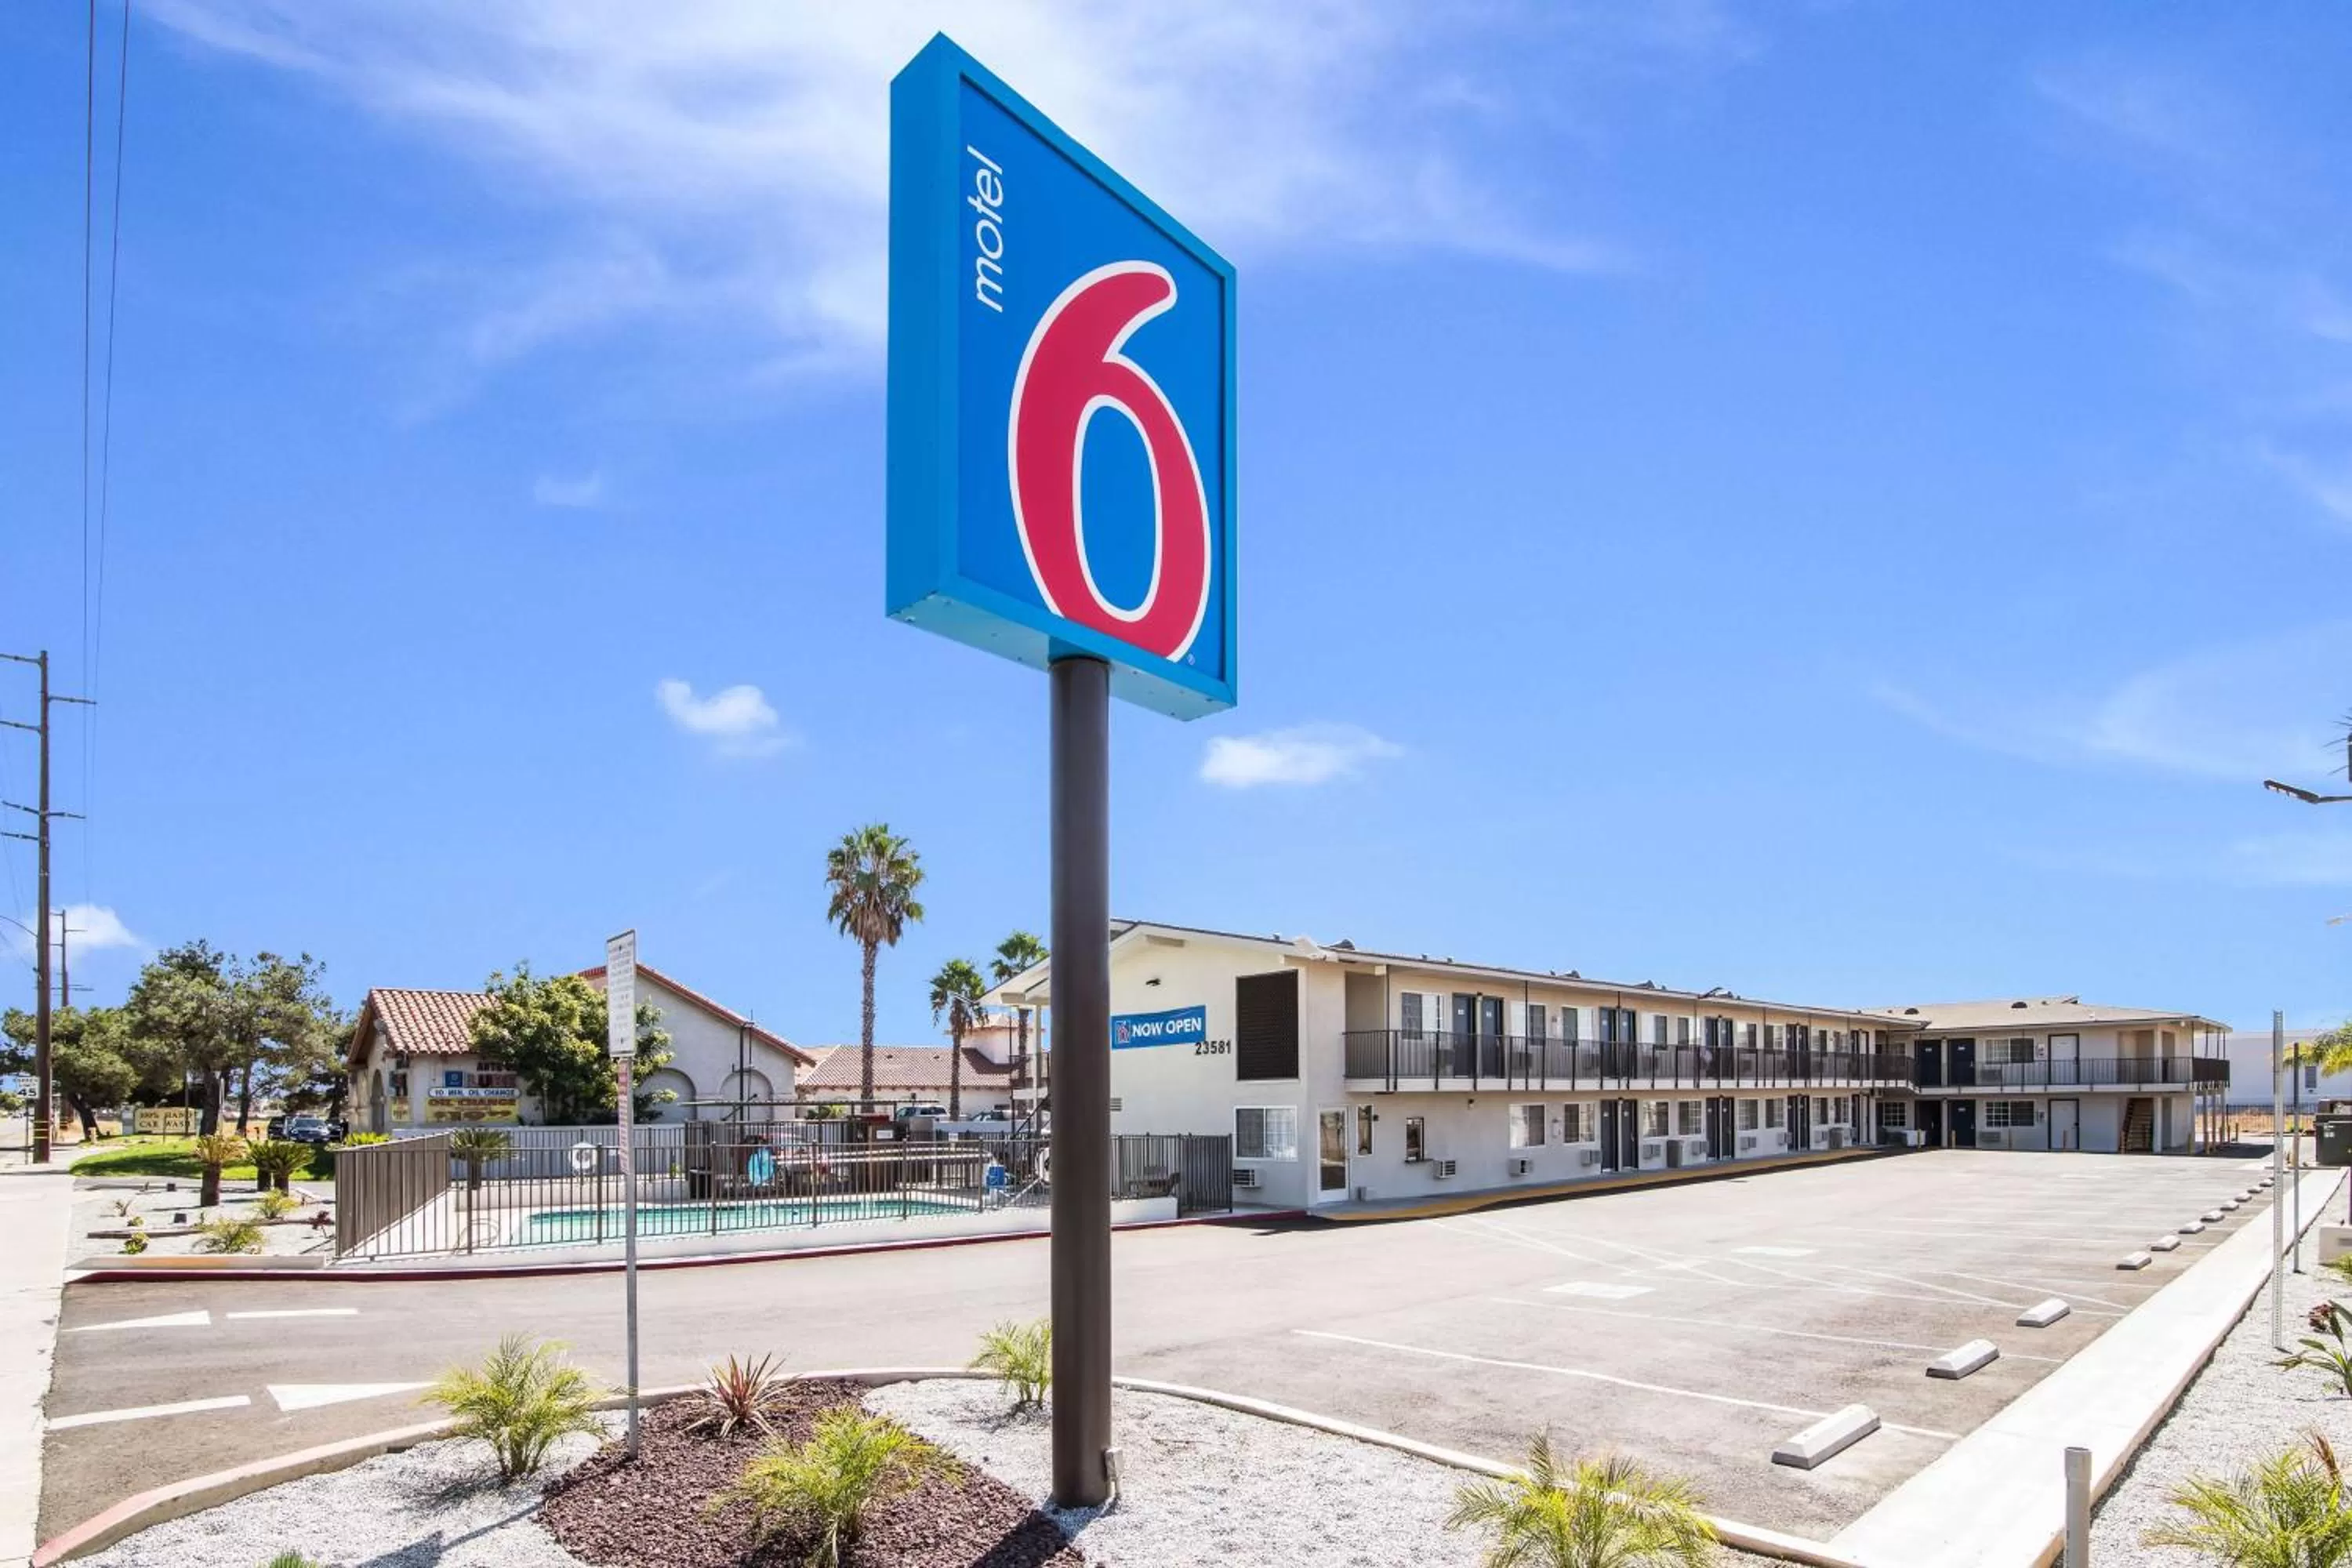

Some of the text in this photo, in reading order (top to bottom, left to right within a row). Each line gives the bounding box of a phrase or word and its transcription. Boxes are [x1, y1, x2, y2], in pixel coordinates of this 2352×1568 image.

[967, 144, 1004, 313] motel
[1008, 260, 1211, 663] 6
[1131, 1018, 1202, 1037] NOW OPEN
[1194, 1039, 1232, 1055] 23581
